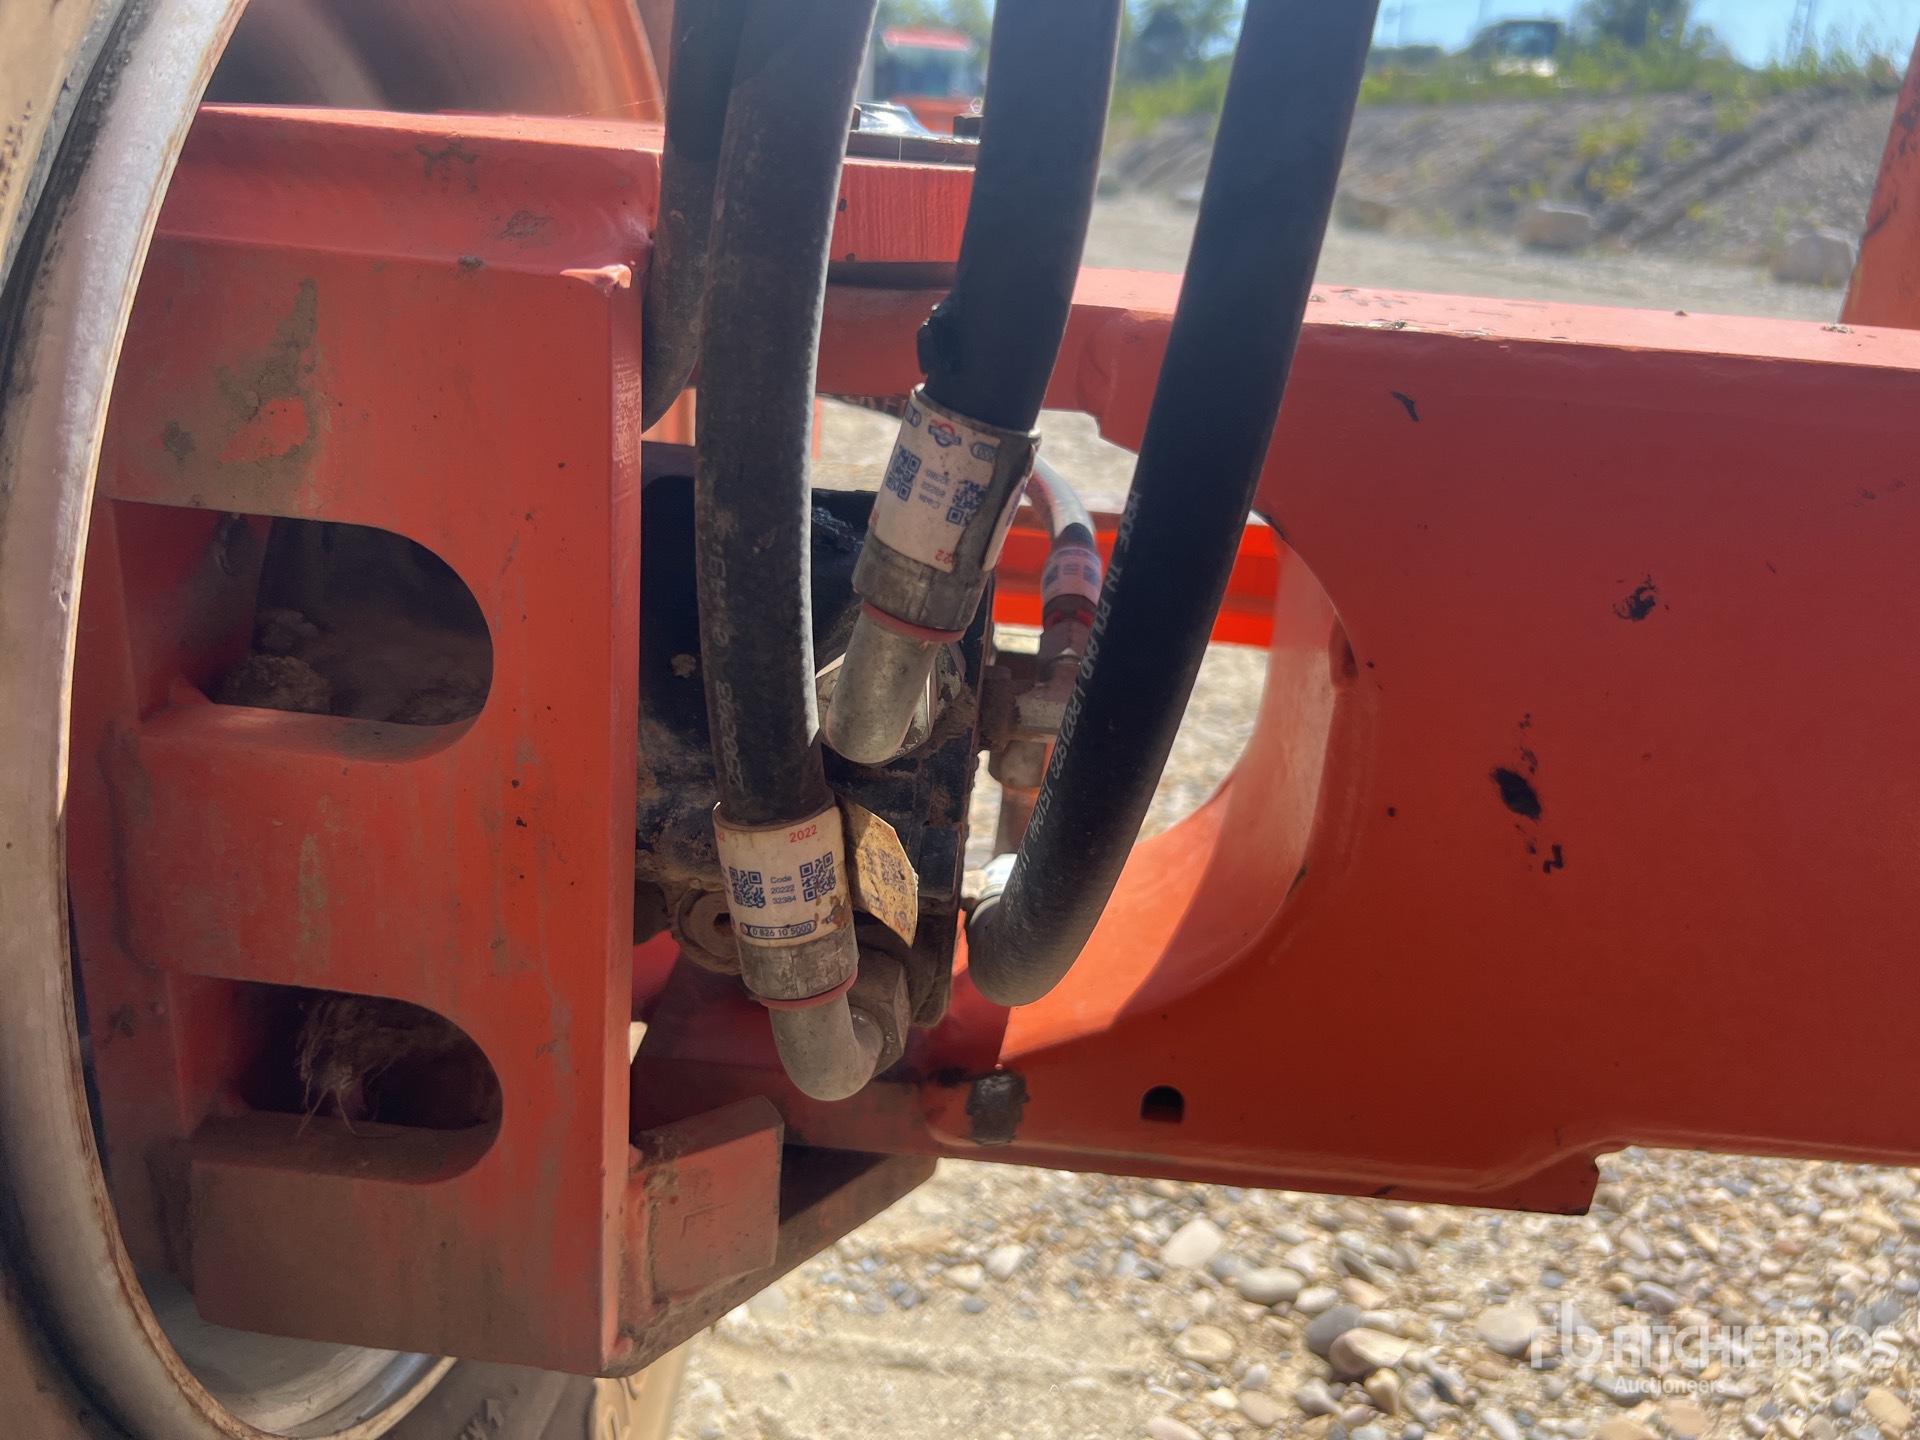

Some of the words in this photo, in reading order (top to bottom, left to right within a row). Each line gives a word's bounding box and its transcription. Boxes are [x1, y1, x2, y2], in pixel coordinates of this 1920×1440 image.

[1117, 490, 1141, 552] MADE
[1103, 560, 1122, 593] IN
[1081, 600, 1111, 680] POLAND
[789, 825, 818, 843] 2022
[770, 875, 792, 884] Code
[770, 885, 795, 895] 20222
[772, 895, 797, 904] 32384
[760, 929, 775, 937] 826
[778, 927, 788, 936] 10
[790, 923, 812, 935] 5000
